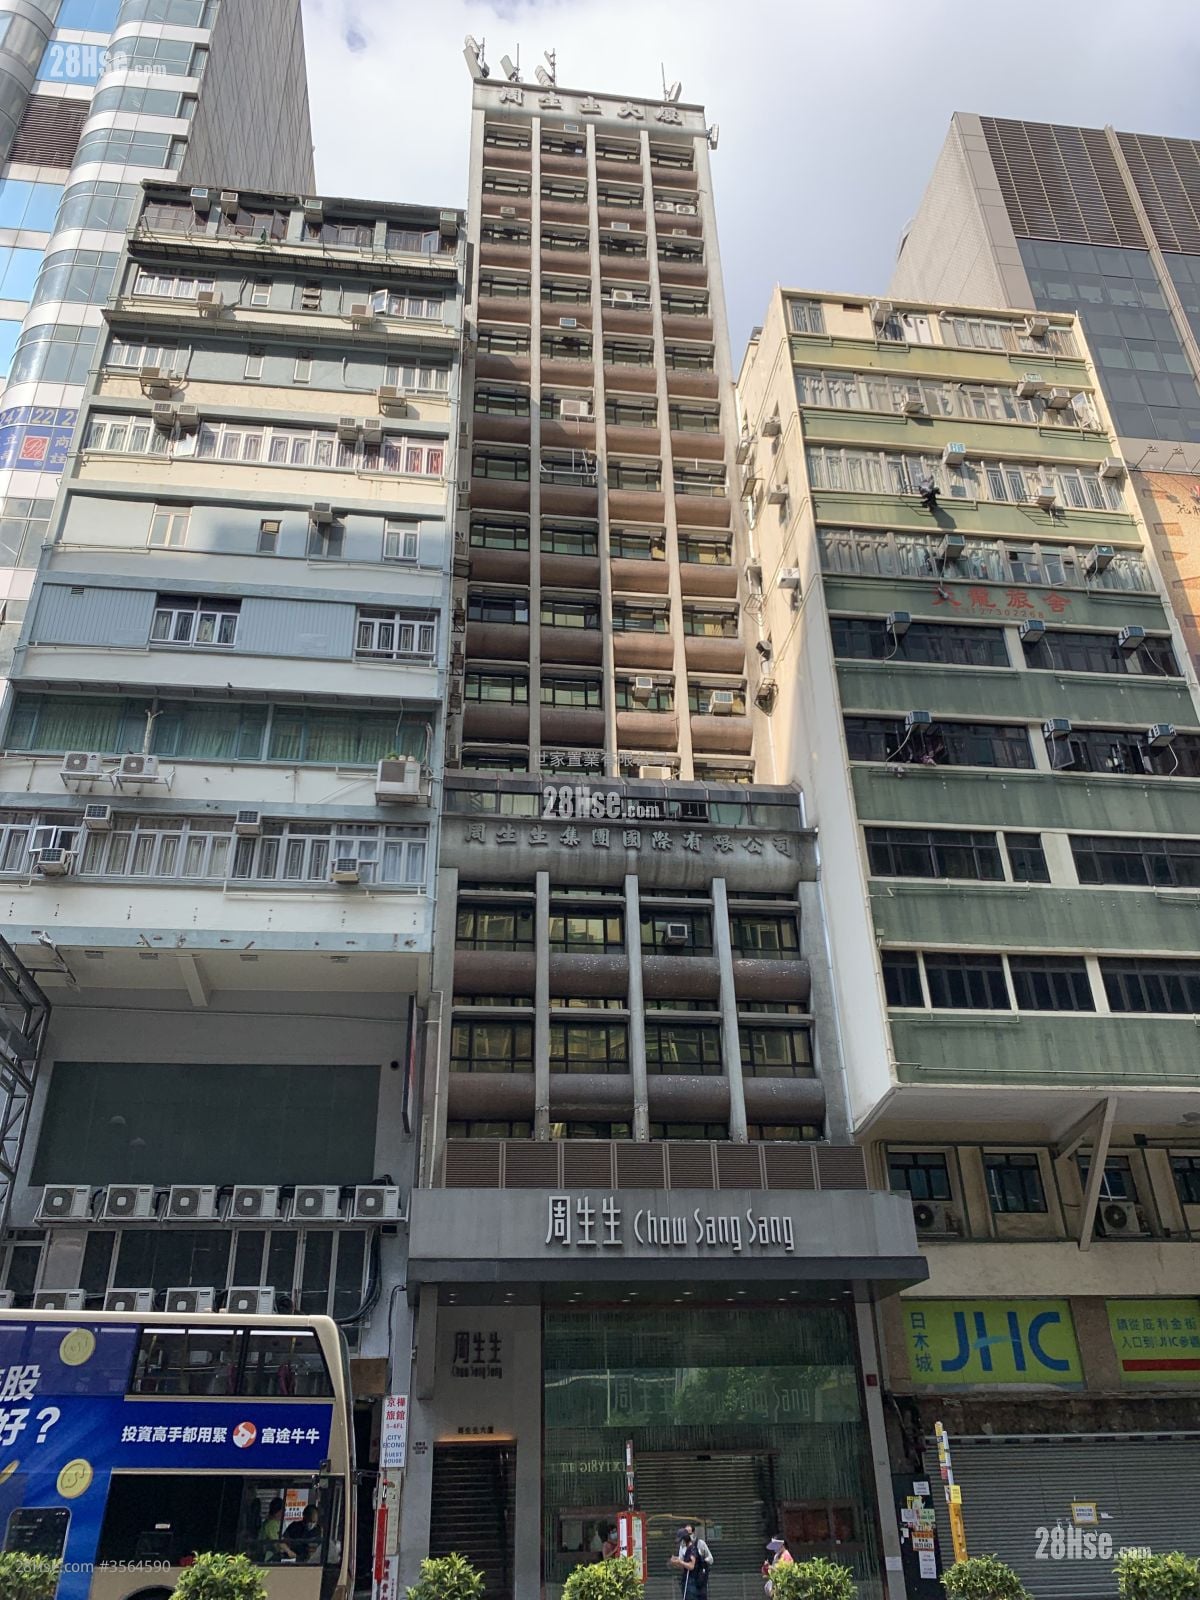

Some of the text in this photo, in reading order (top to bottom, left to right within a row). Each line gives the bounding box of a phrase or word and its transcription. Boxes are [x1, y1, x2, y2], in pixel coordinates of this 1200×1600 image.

[464, 823, 793, 857] 周生生集團國際有限公司
[545, 1195, 795, 1251] 周生生 Chow Sang Sang
[453, 1331, 503, 1364] 周生生
[911, 1312, 934, 1372] 日本城
[941, 1311, 1071, 1372] JHC
[121, 1426, 320, 1445] 投資高手都用緊 富途牛牛
